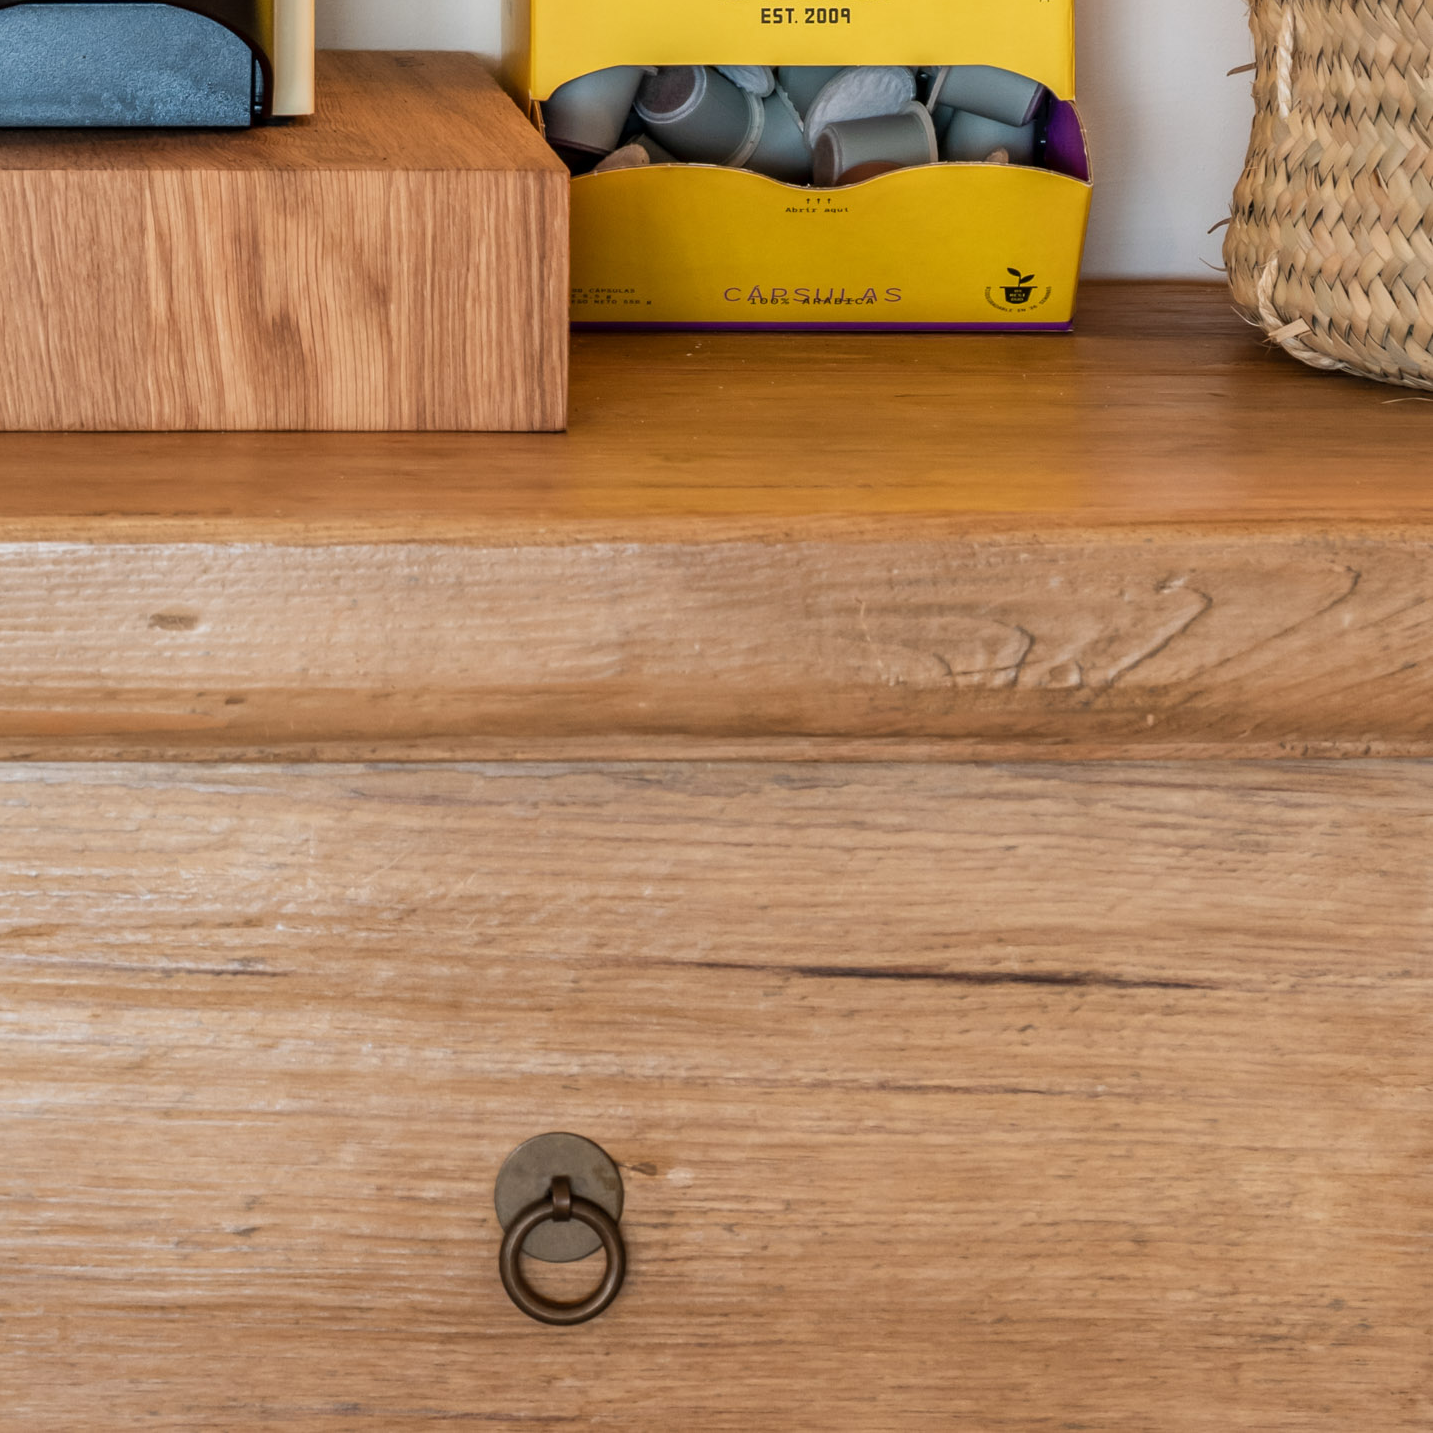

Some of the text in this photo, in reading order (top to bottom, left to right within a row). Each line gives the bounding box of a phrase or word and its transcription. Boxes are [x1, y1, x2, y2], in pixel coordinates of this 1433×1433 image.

[761, 8, 850, 23] EST. 2009
[724, 285, 902, 302] CÁPSULAS
